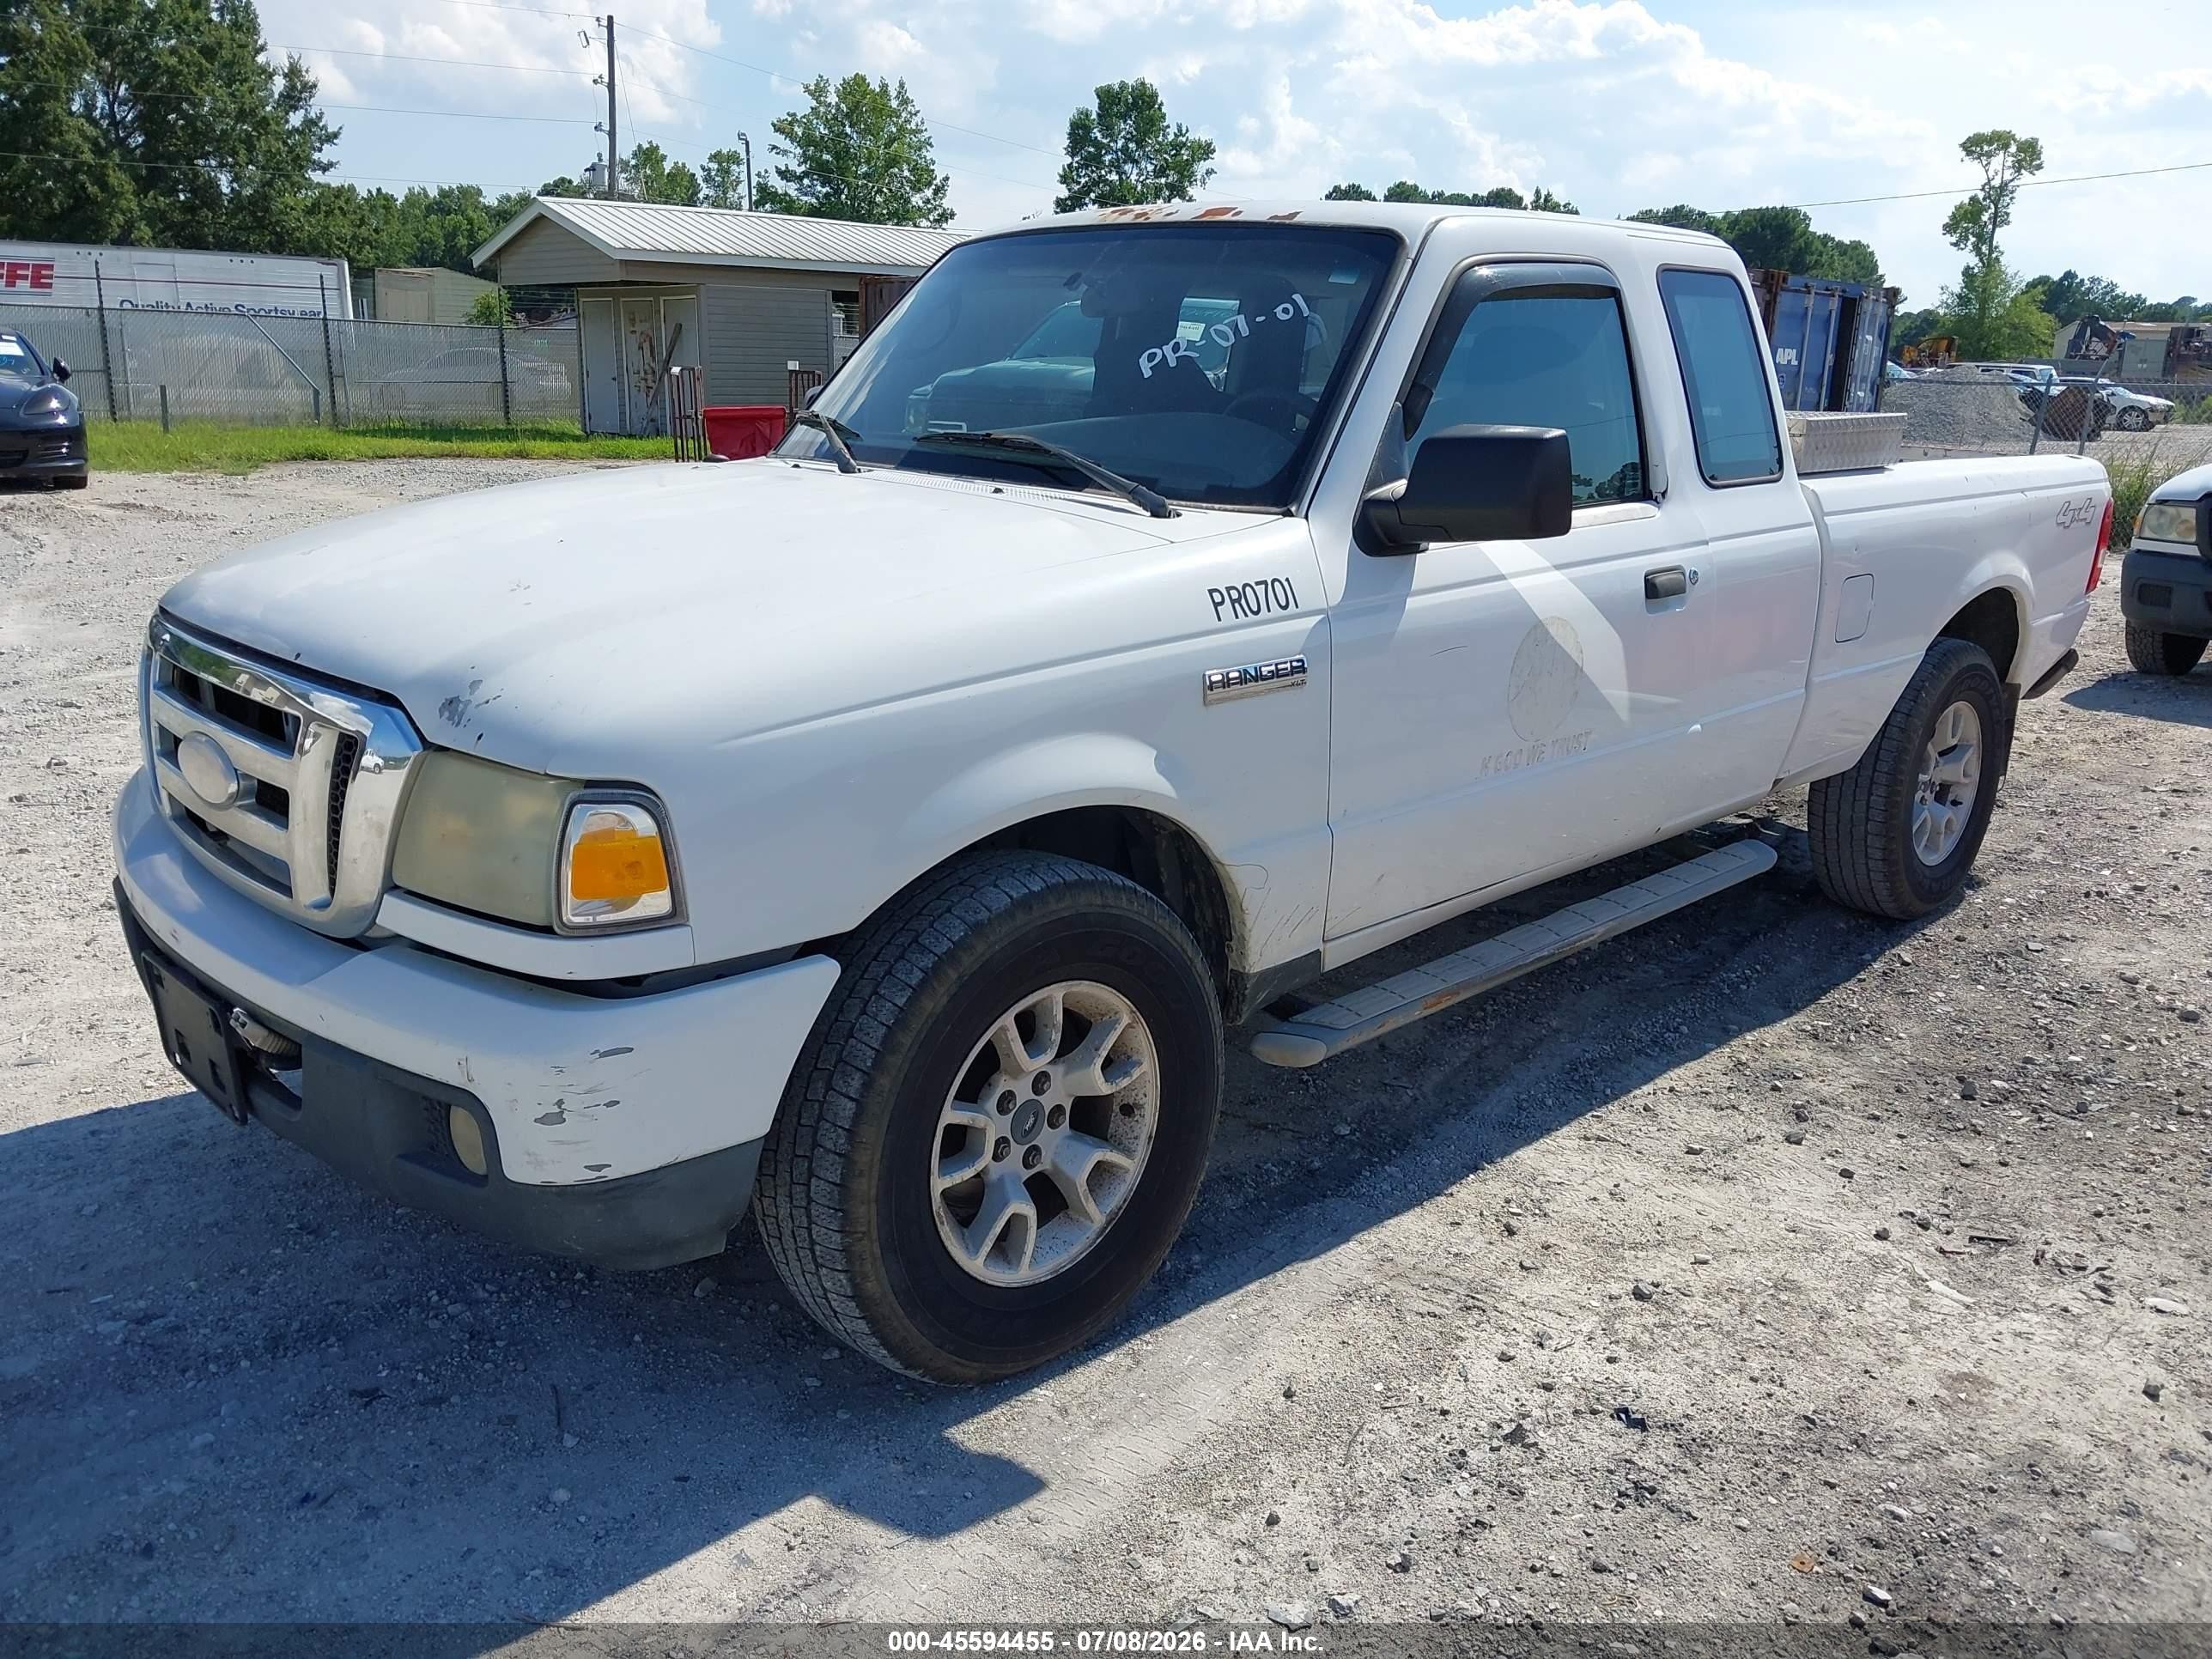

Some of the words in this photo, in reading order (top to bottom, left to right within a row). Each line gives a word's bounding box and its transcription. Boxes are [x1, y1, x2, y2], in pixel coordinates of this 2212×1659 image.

[0, 261, 54, 289] FE
[1139, 293, 1310, 378] PR-07-01
[1775, 348, 1799, 366] APL
[1207, 577, 1299, 623] PR0701
[1207, 658, 1308, 692] RANGER
